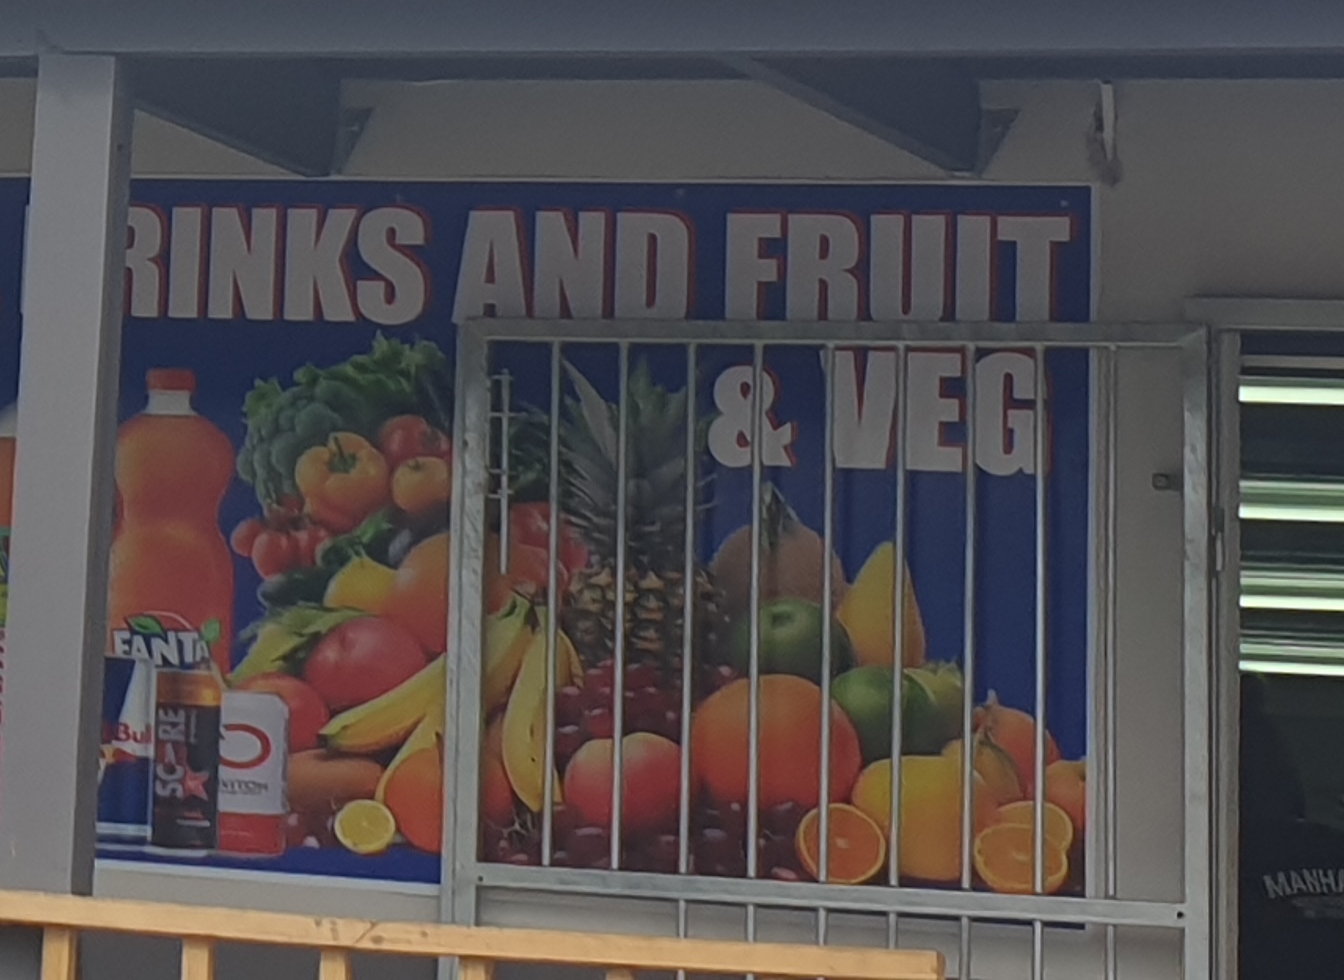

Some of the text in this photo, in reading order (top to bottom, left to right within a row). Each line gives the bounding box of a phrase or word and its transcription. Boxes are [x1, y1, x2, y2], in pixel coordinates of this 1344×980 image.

[24, 202, 434, 325] RINKS
[452, 205, 696, 323] AND
[724, 210, 1078, 323] FRUIT
[708, 346, 1051, 476] & VEG
[156, 708, 185, 798] SCRE
